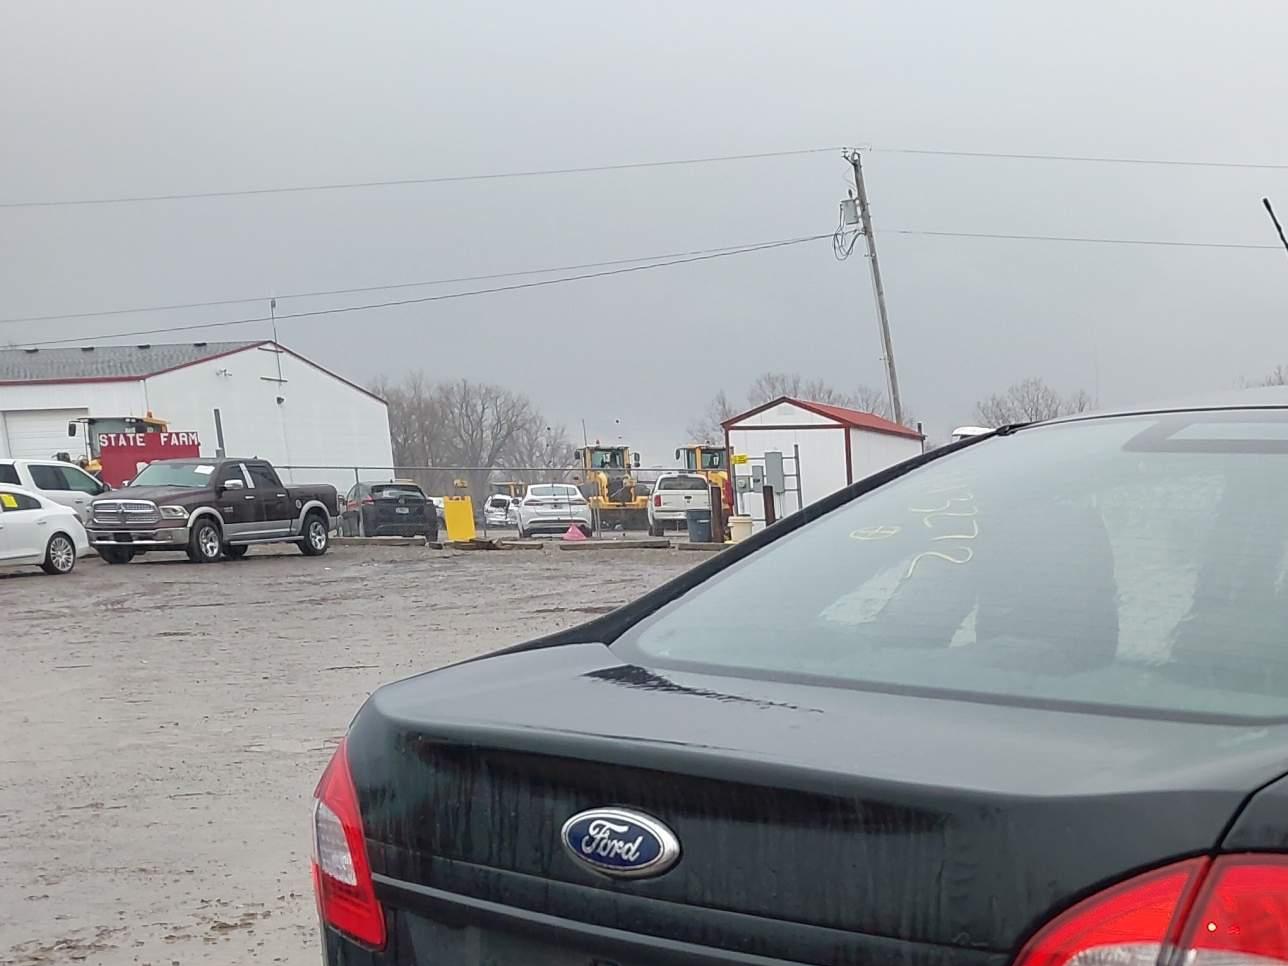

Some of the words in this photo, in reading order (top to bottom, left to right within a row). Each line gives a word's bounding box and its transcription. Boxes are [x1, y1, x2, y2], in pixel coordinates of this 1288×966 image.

[100, 433, 146, 447] STATE
[160, 433, 198, 446] FARM
[581, 819, 643, 862] Ford
